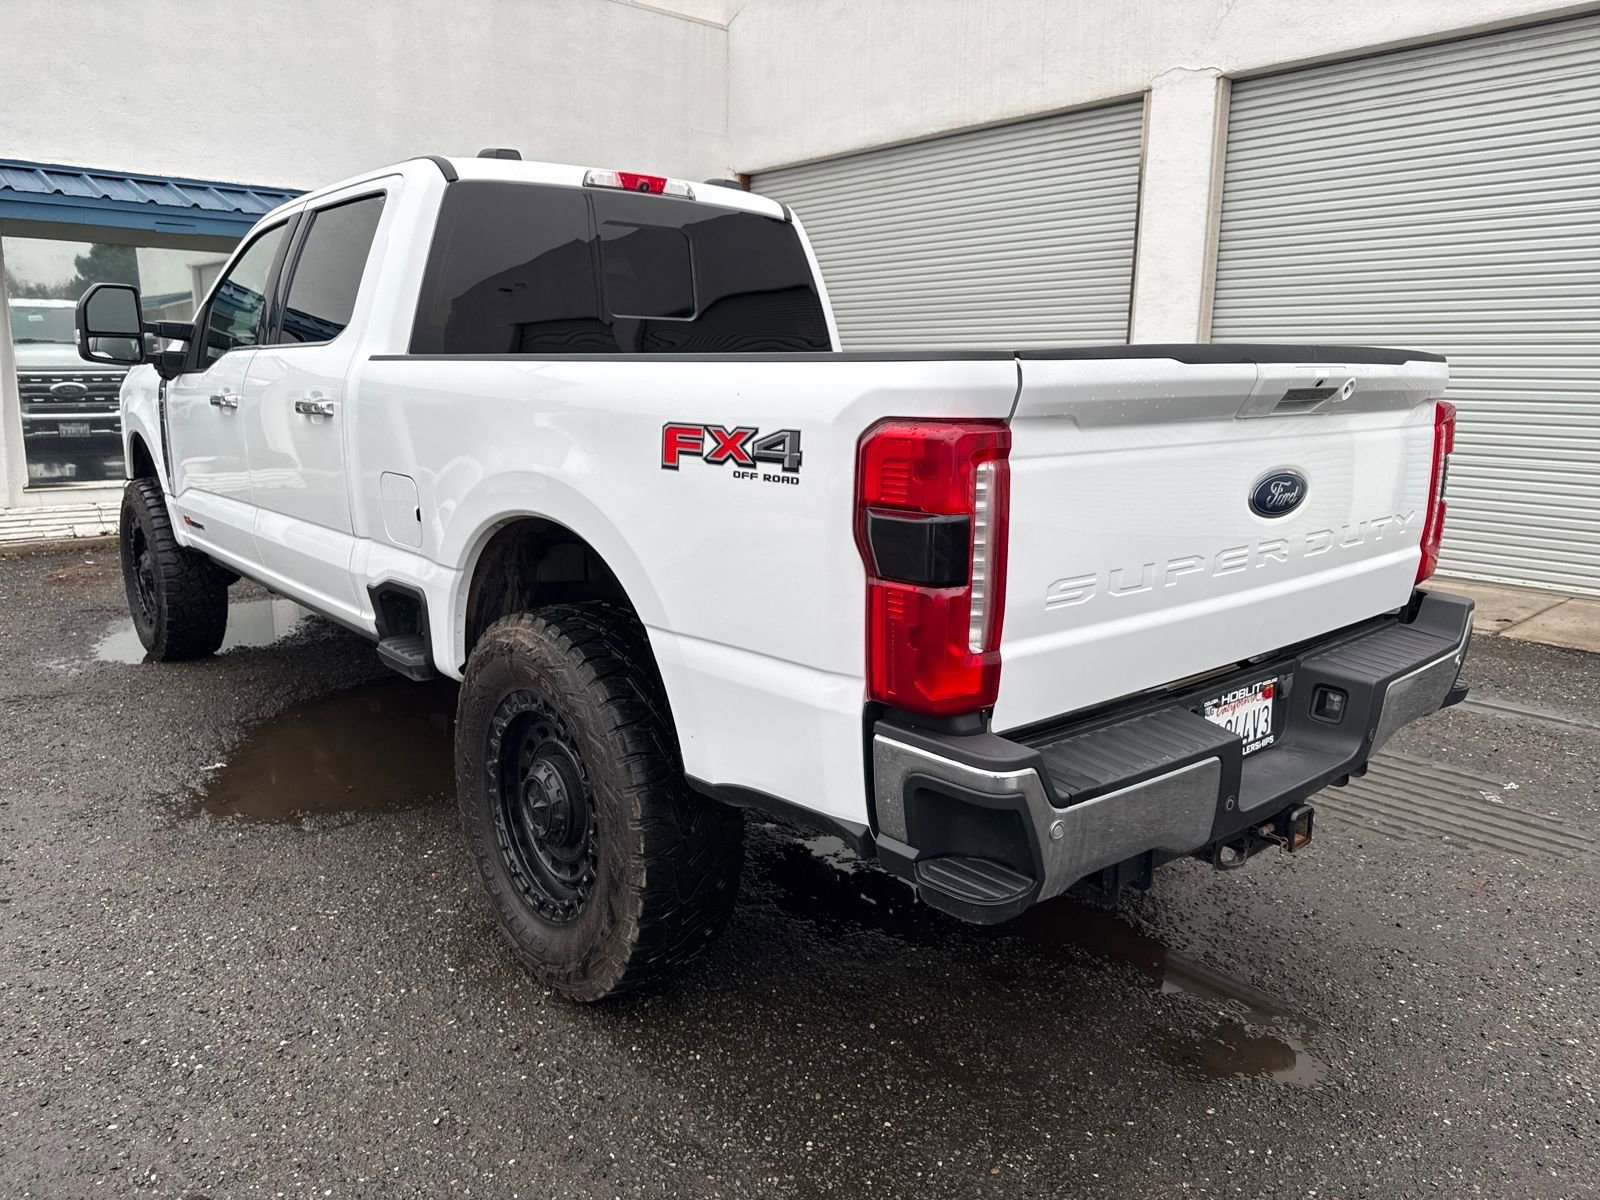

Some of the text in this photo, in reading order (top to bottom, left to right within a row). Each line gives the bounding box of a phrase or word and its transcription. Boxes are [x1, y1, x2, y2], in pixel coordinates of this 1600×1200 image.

[661, 421, 802, 474] FX4
[733, 470, 799, 485] OFF ROAD
[1265, 480, 1299, 508] Ford
[1044, 509, 1416, 611] SUPER DUTY
[1221, 682, 1262, 705] HOBLIT
